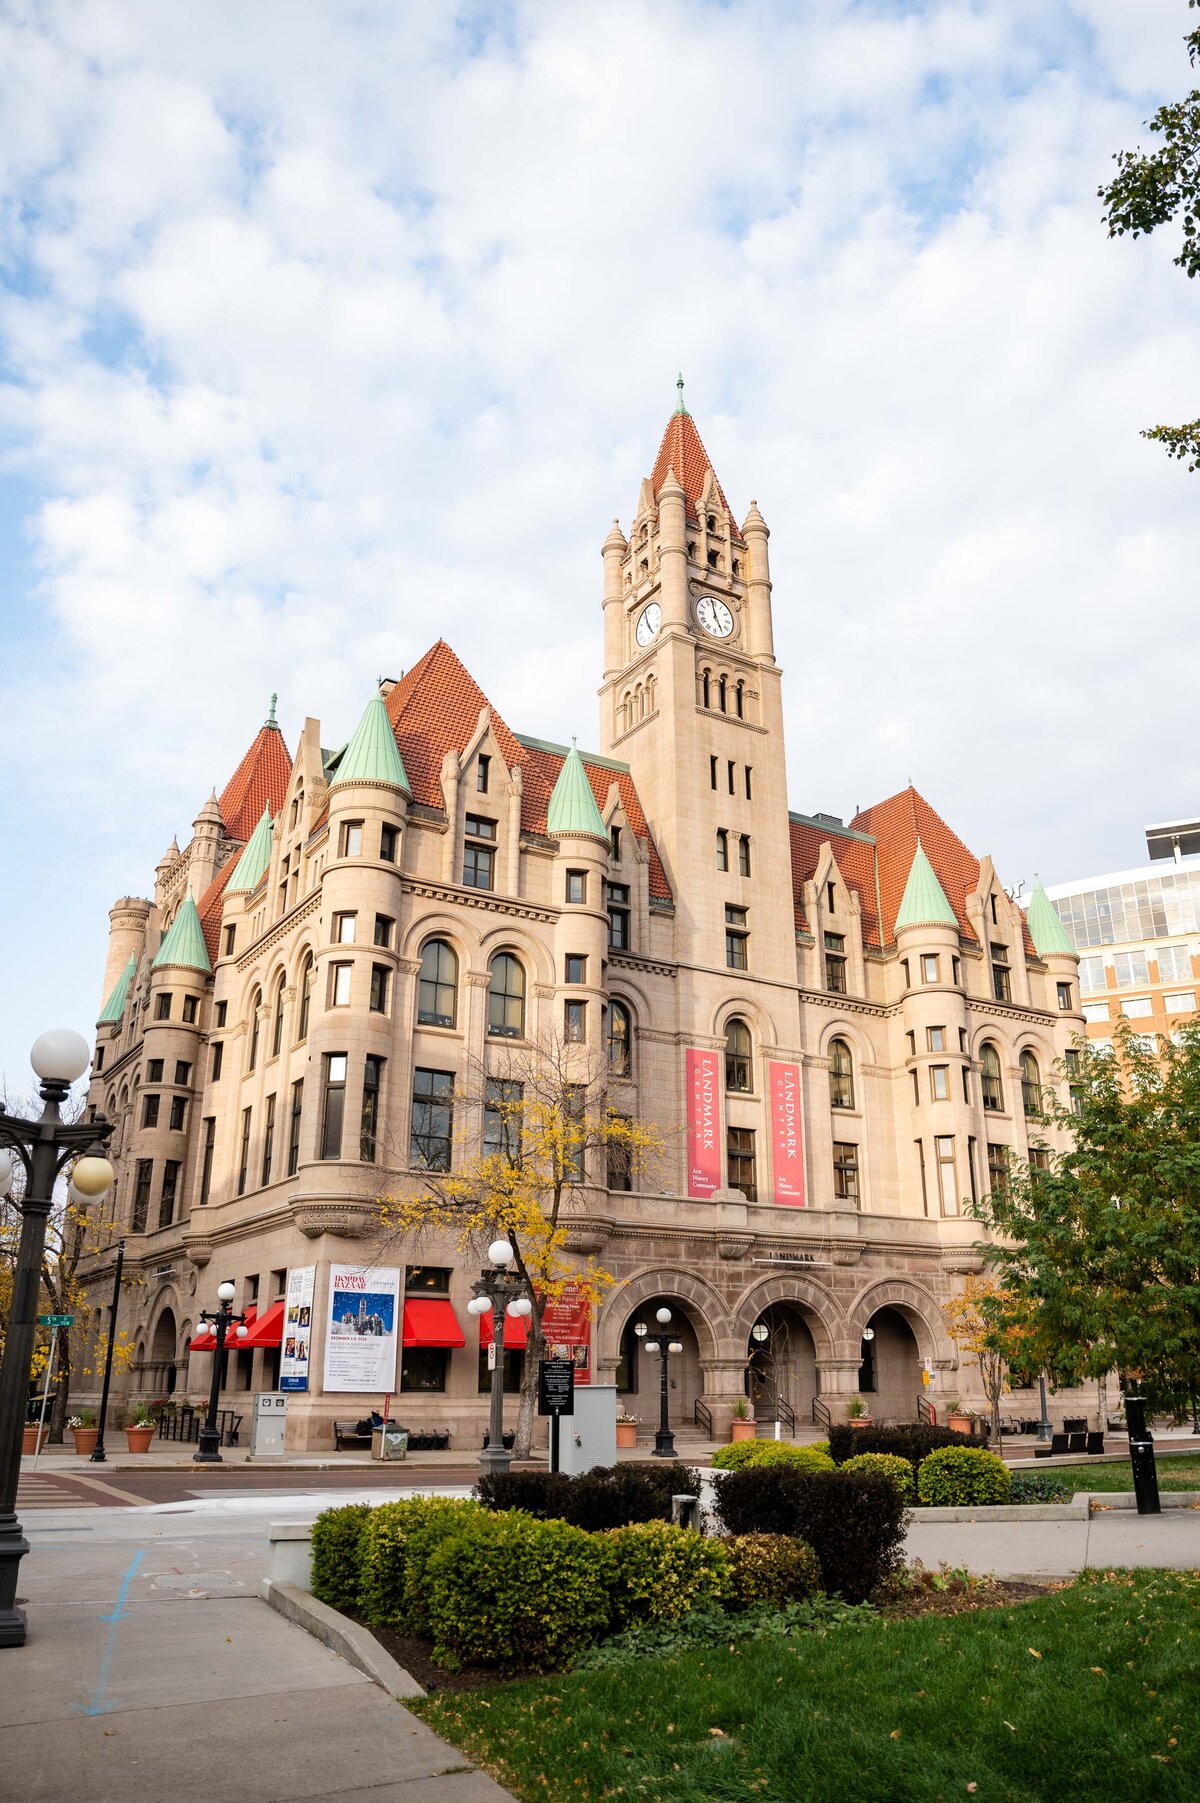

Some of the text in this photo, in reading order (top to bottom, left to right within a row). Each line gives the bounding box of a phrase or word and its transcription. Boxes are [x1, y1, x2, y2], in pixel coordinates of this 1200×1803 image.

[694, 1067, 702, 1139] CENTER
[702, 1059, 714, 1150] LANDMARK
[777, 1080, 786, 1148] CENTER
[784, 1071, 797, 1159] LANDMARK
[692, 1174, 709, 1183] History
[692, 1181, 717, 1191] Community
[778, 1182, 793, 1190] History
[334, 1281, 367, 1290] BAZAAR
[47, 1317, 51, 1325] 5
